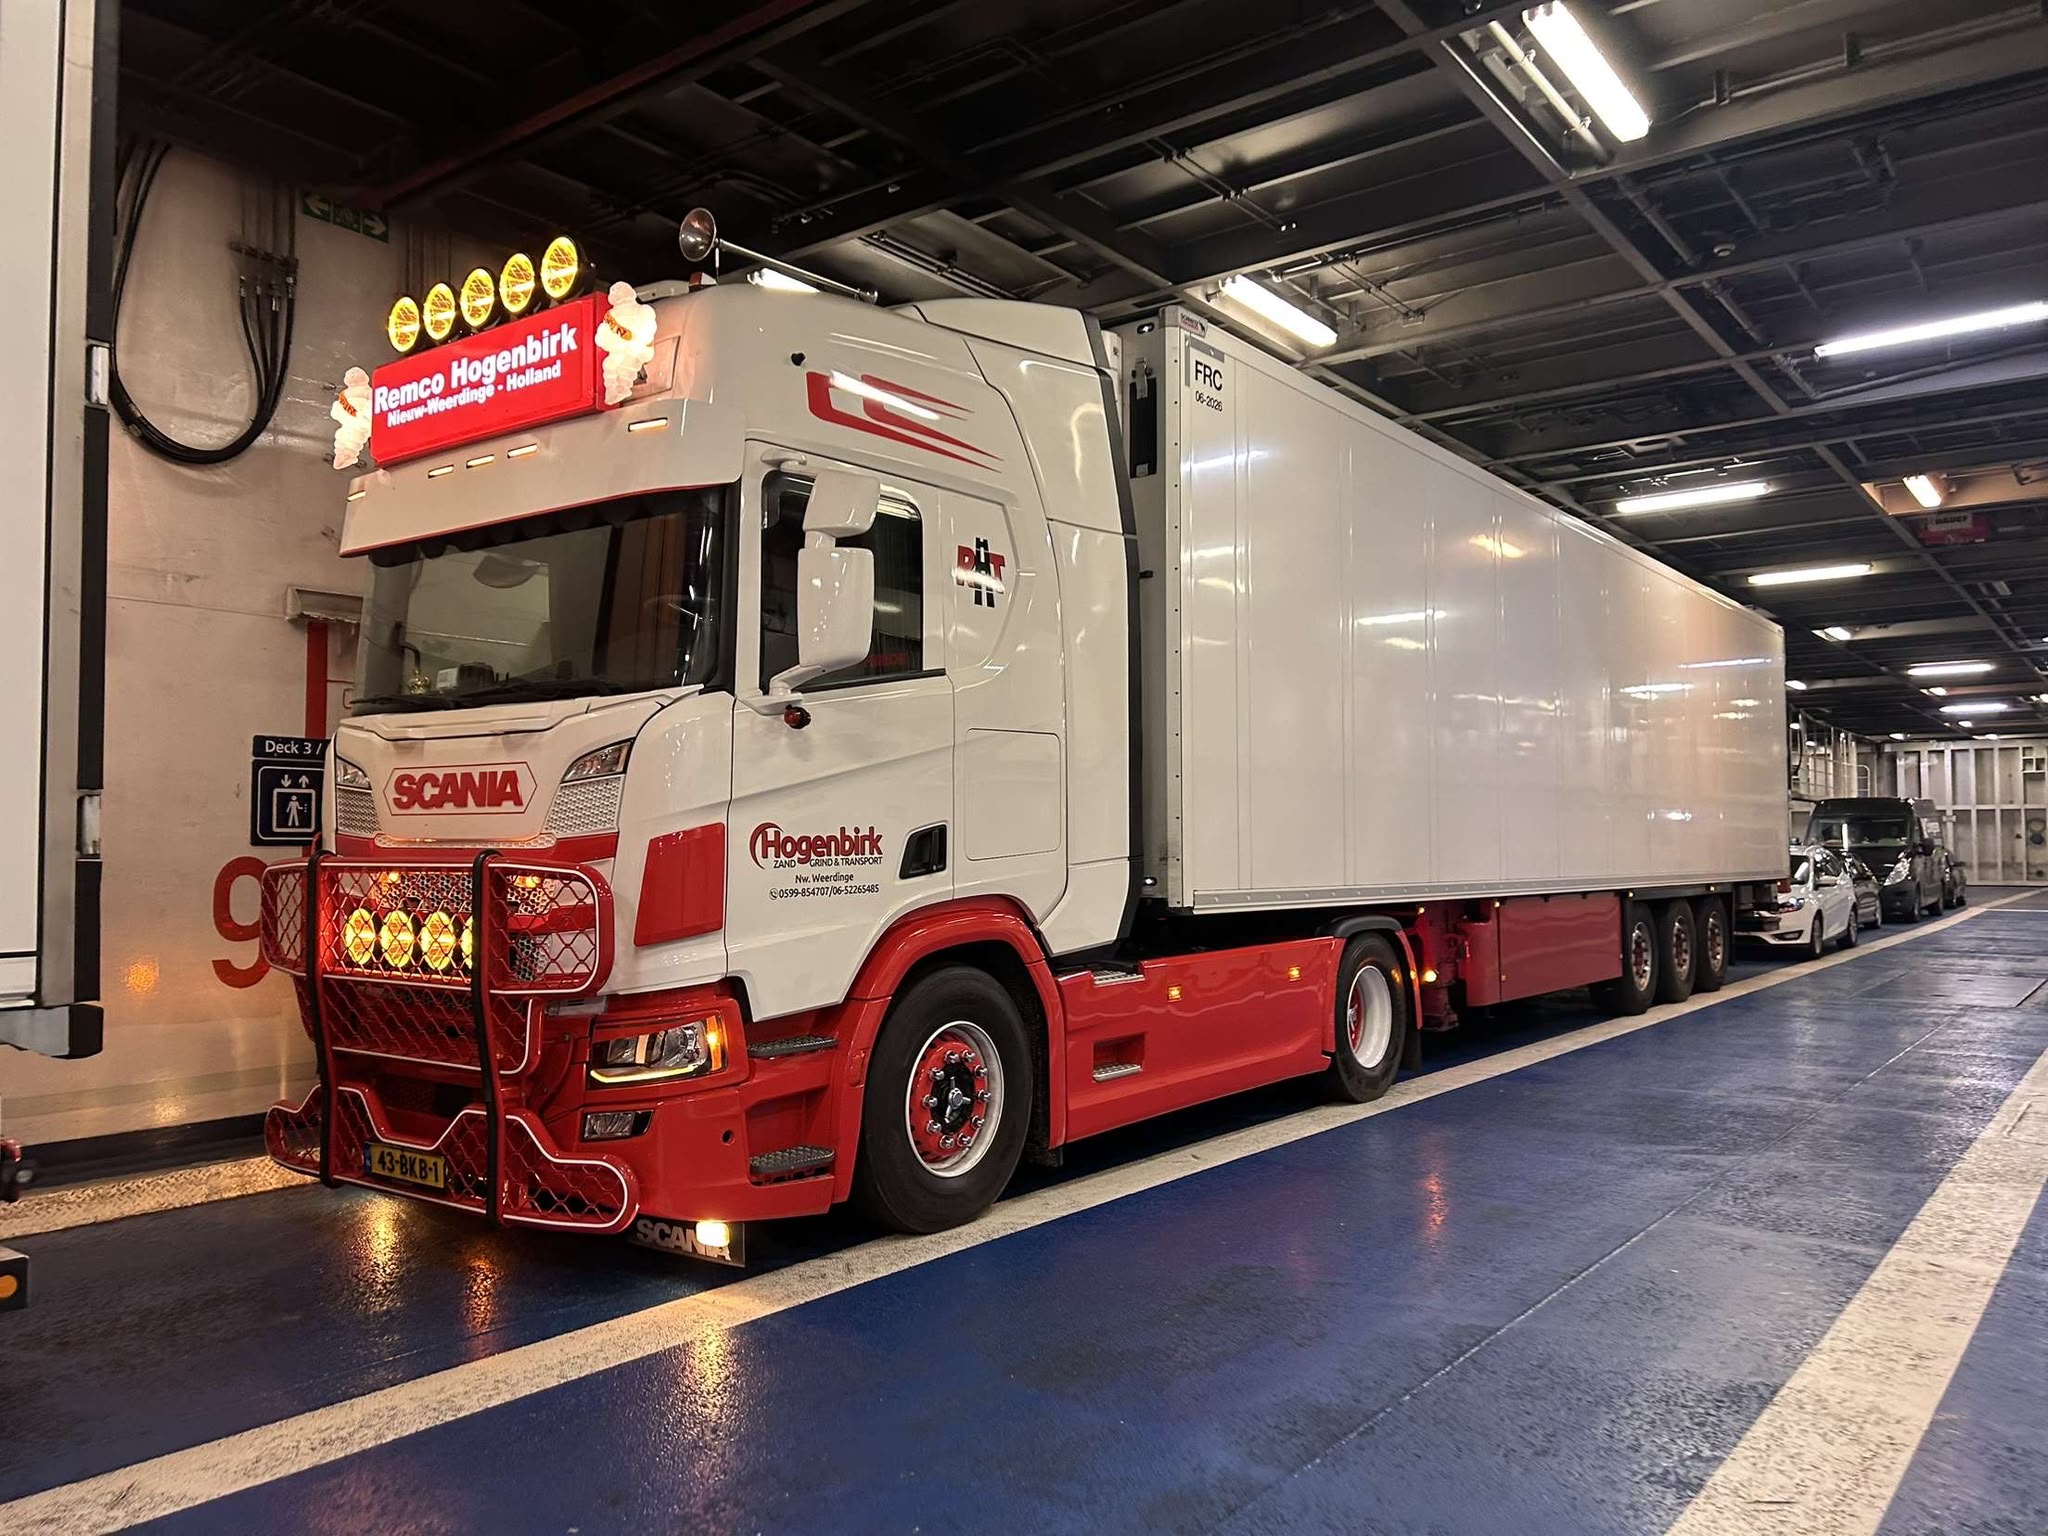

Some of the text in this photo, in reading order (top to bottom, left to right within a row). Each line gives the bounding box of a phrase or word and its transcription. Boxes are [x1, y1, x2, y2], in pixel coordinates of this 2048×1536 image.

[374, 372, 446, 414] Remco
[450, 323, 578, 388] Hogenbirk
[1195, 360, 1223, 391] FRC
[387, 383, 495, 428] Nieuw-Weerdinge
[506, 360, 561, 392] Holland
[1195, 390, 1223, 412] 06-2026
[265, 740, 299, 755] Deck
[303, 741, 312, 755] 3
[393, 770, 524, 810] SCANIA
[761, 826, 883, 864] Hogenbirk
[773, 856, 883, 869] ZAND GRIND & TRANSPORT
[795, 872, 854, 884] Nw. Weerdinge
[779, 884, 880, 898] 0599-854707/06-52265485
[377, 1150, 439, 1182] 43-BKB-1
